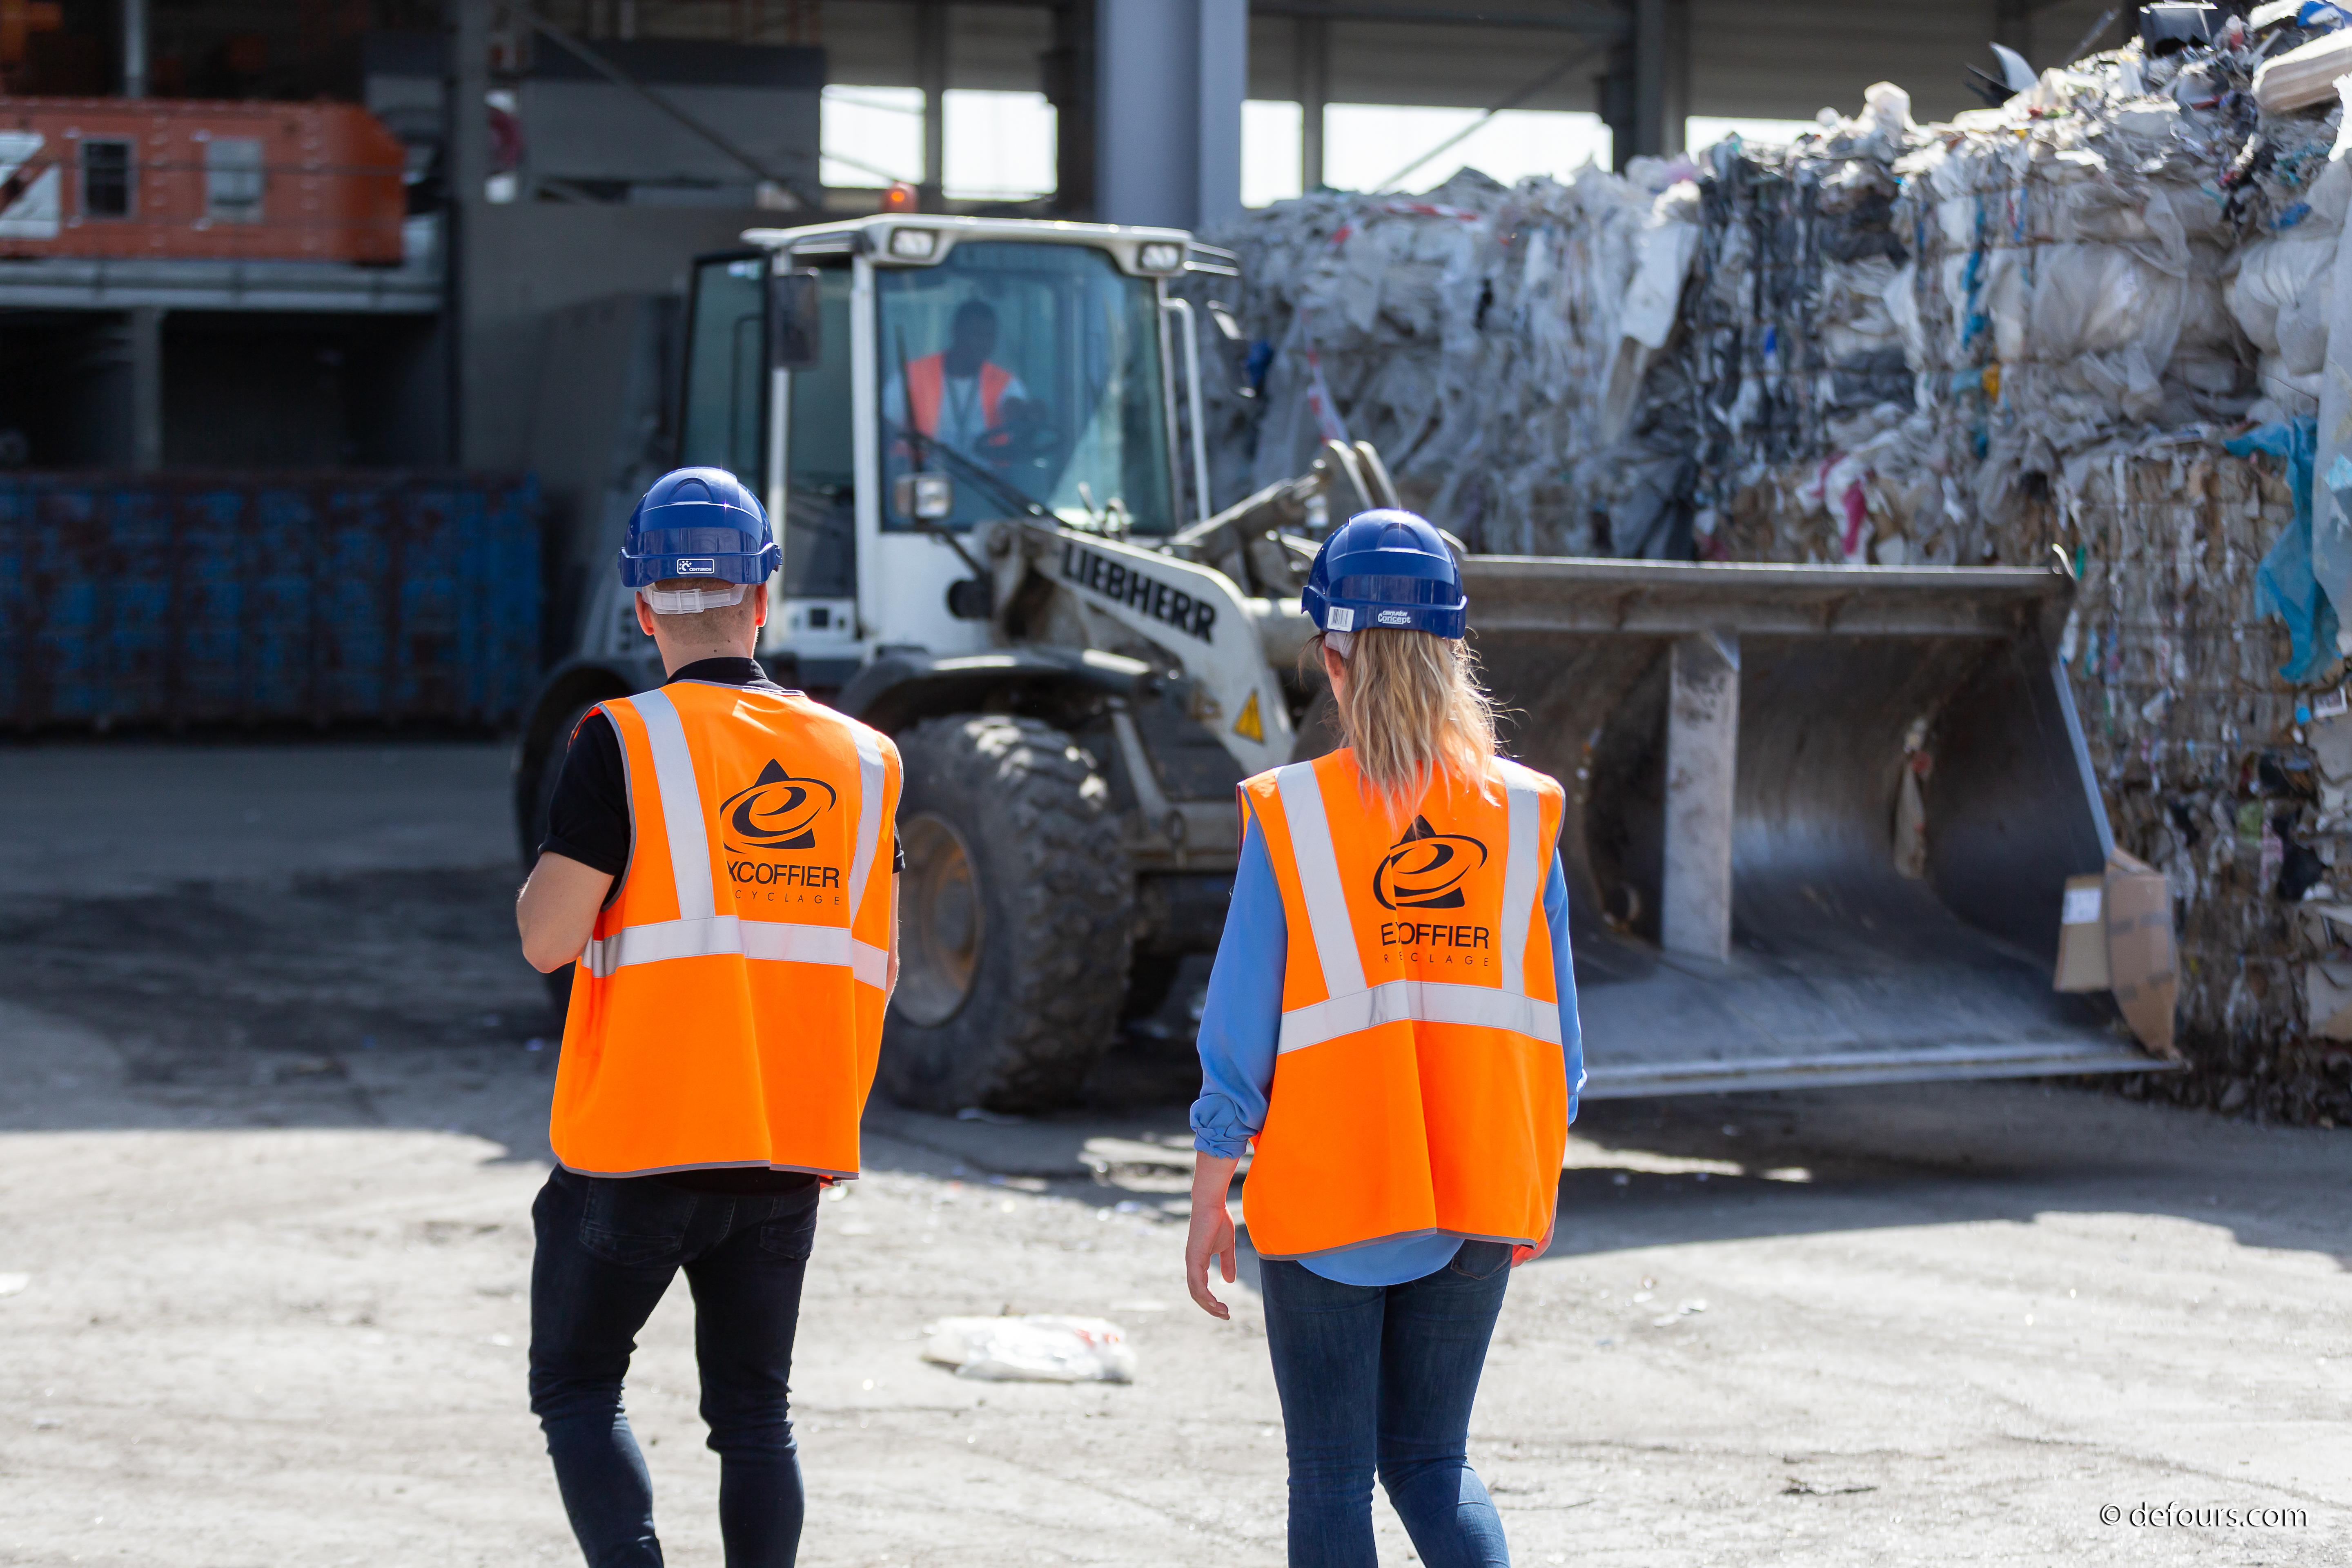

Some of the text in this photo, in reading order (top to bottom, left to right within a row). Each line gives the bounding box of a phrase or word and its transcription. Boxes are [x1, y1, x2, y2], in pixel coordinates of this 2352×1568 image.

[1062, 543, 1216, 644] LIEBHERR
[1378, 613, 1411, 625] Concept
[726, 860, 840, 889] XCOFFIER
[735, 890, 840, 905] CYCLAGE
